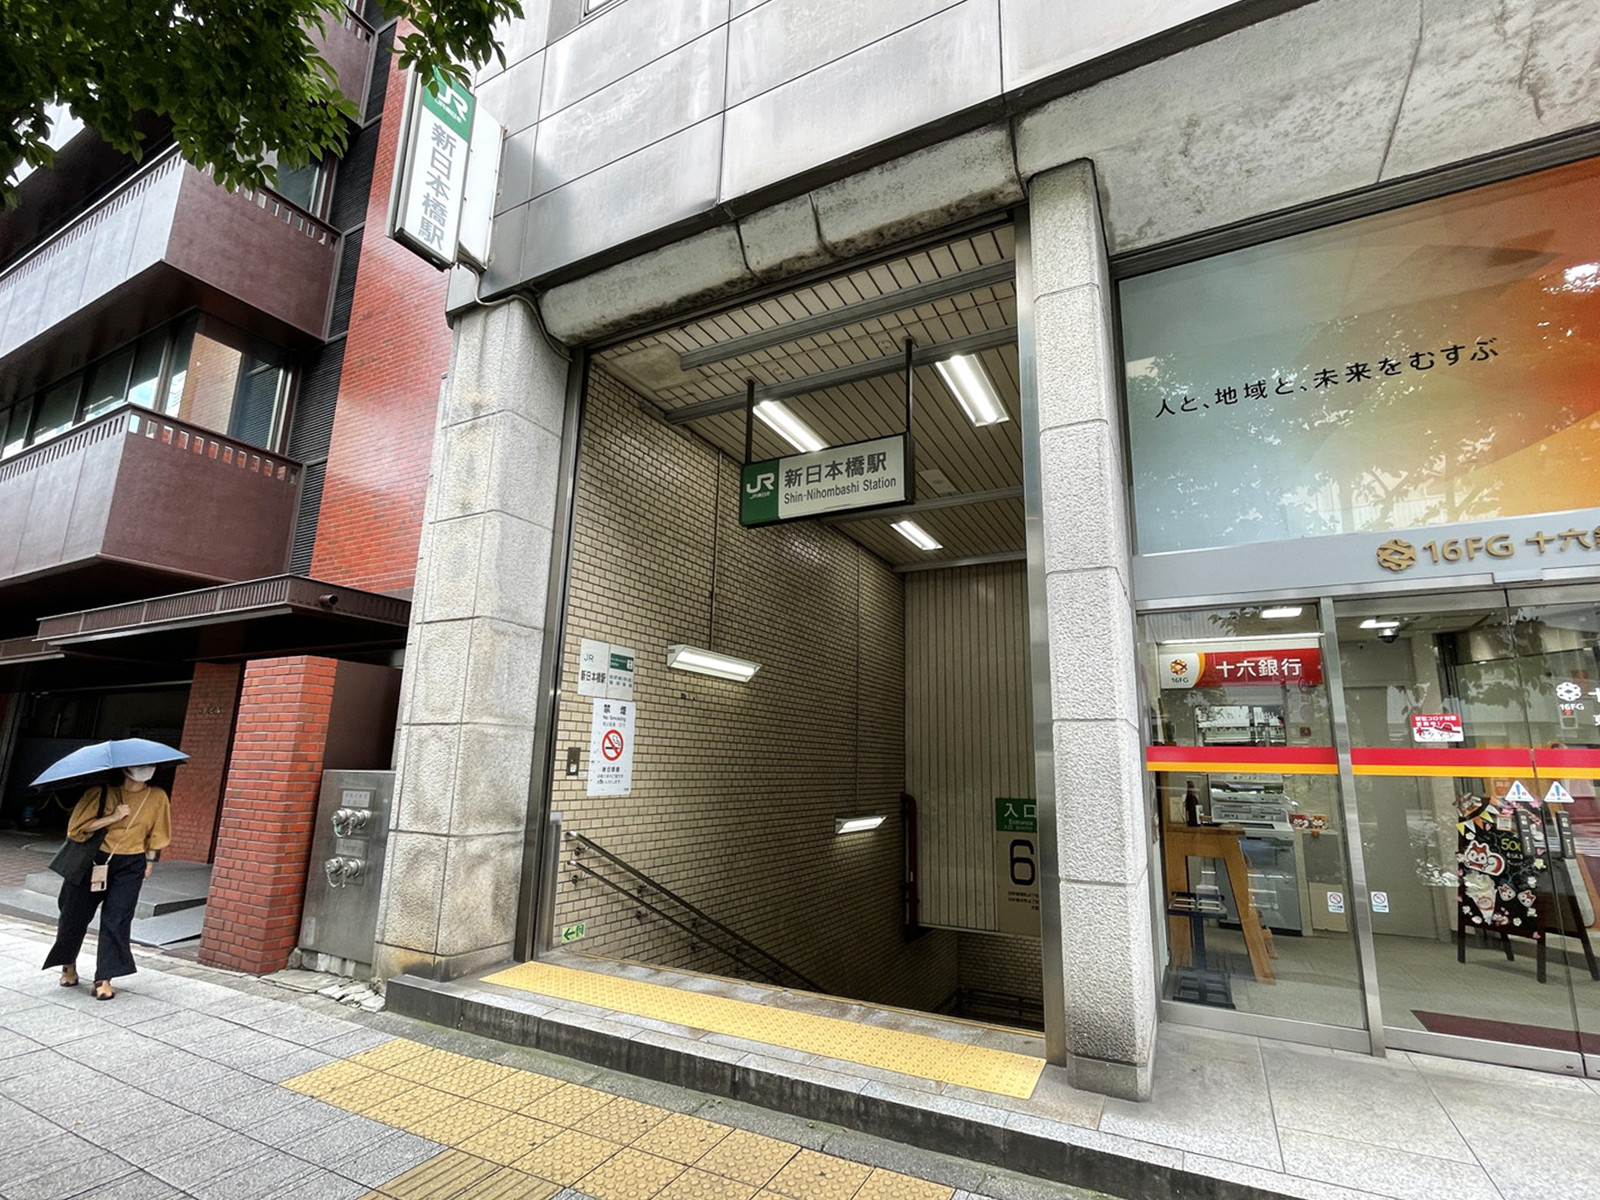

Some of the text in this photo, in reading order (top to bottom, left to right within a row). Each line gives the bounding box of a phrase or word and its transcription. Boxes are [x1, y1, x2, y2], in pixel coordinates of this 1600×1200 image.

[417, 121, 457, 252] 新日本橋駅
[784, 451, 888, 489] 新日本橋駅
[746, 472, 775, 494] JR
[783, 476, 897, 505] Shin-Nihombashi Station
[1422, 533, 1515, 564] 16FG
[583, 653, 595, 663] JR
[1215, 658, 1302, 679] 十六銀行
[1559, 702, 1585, 711] 16FG
[1003, 803, 1037, 819] 入口
[1009, 838, 1036, 887] 6
